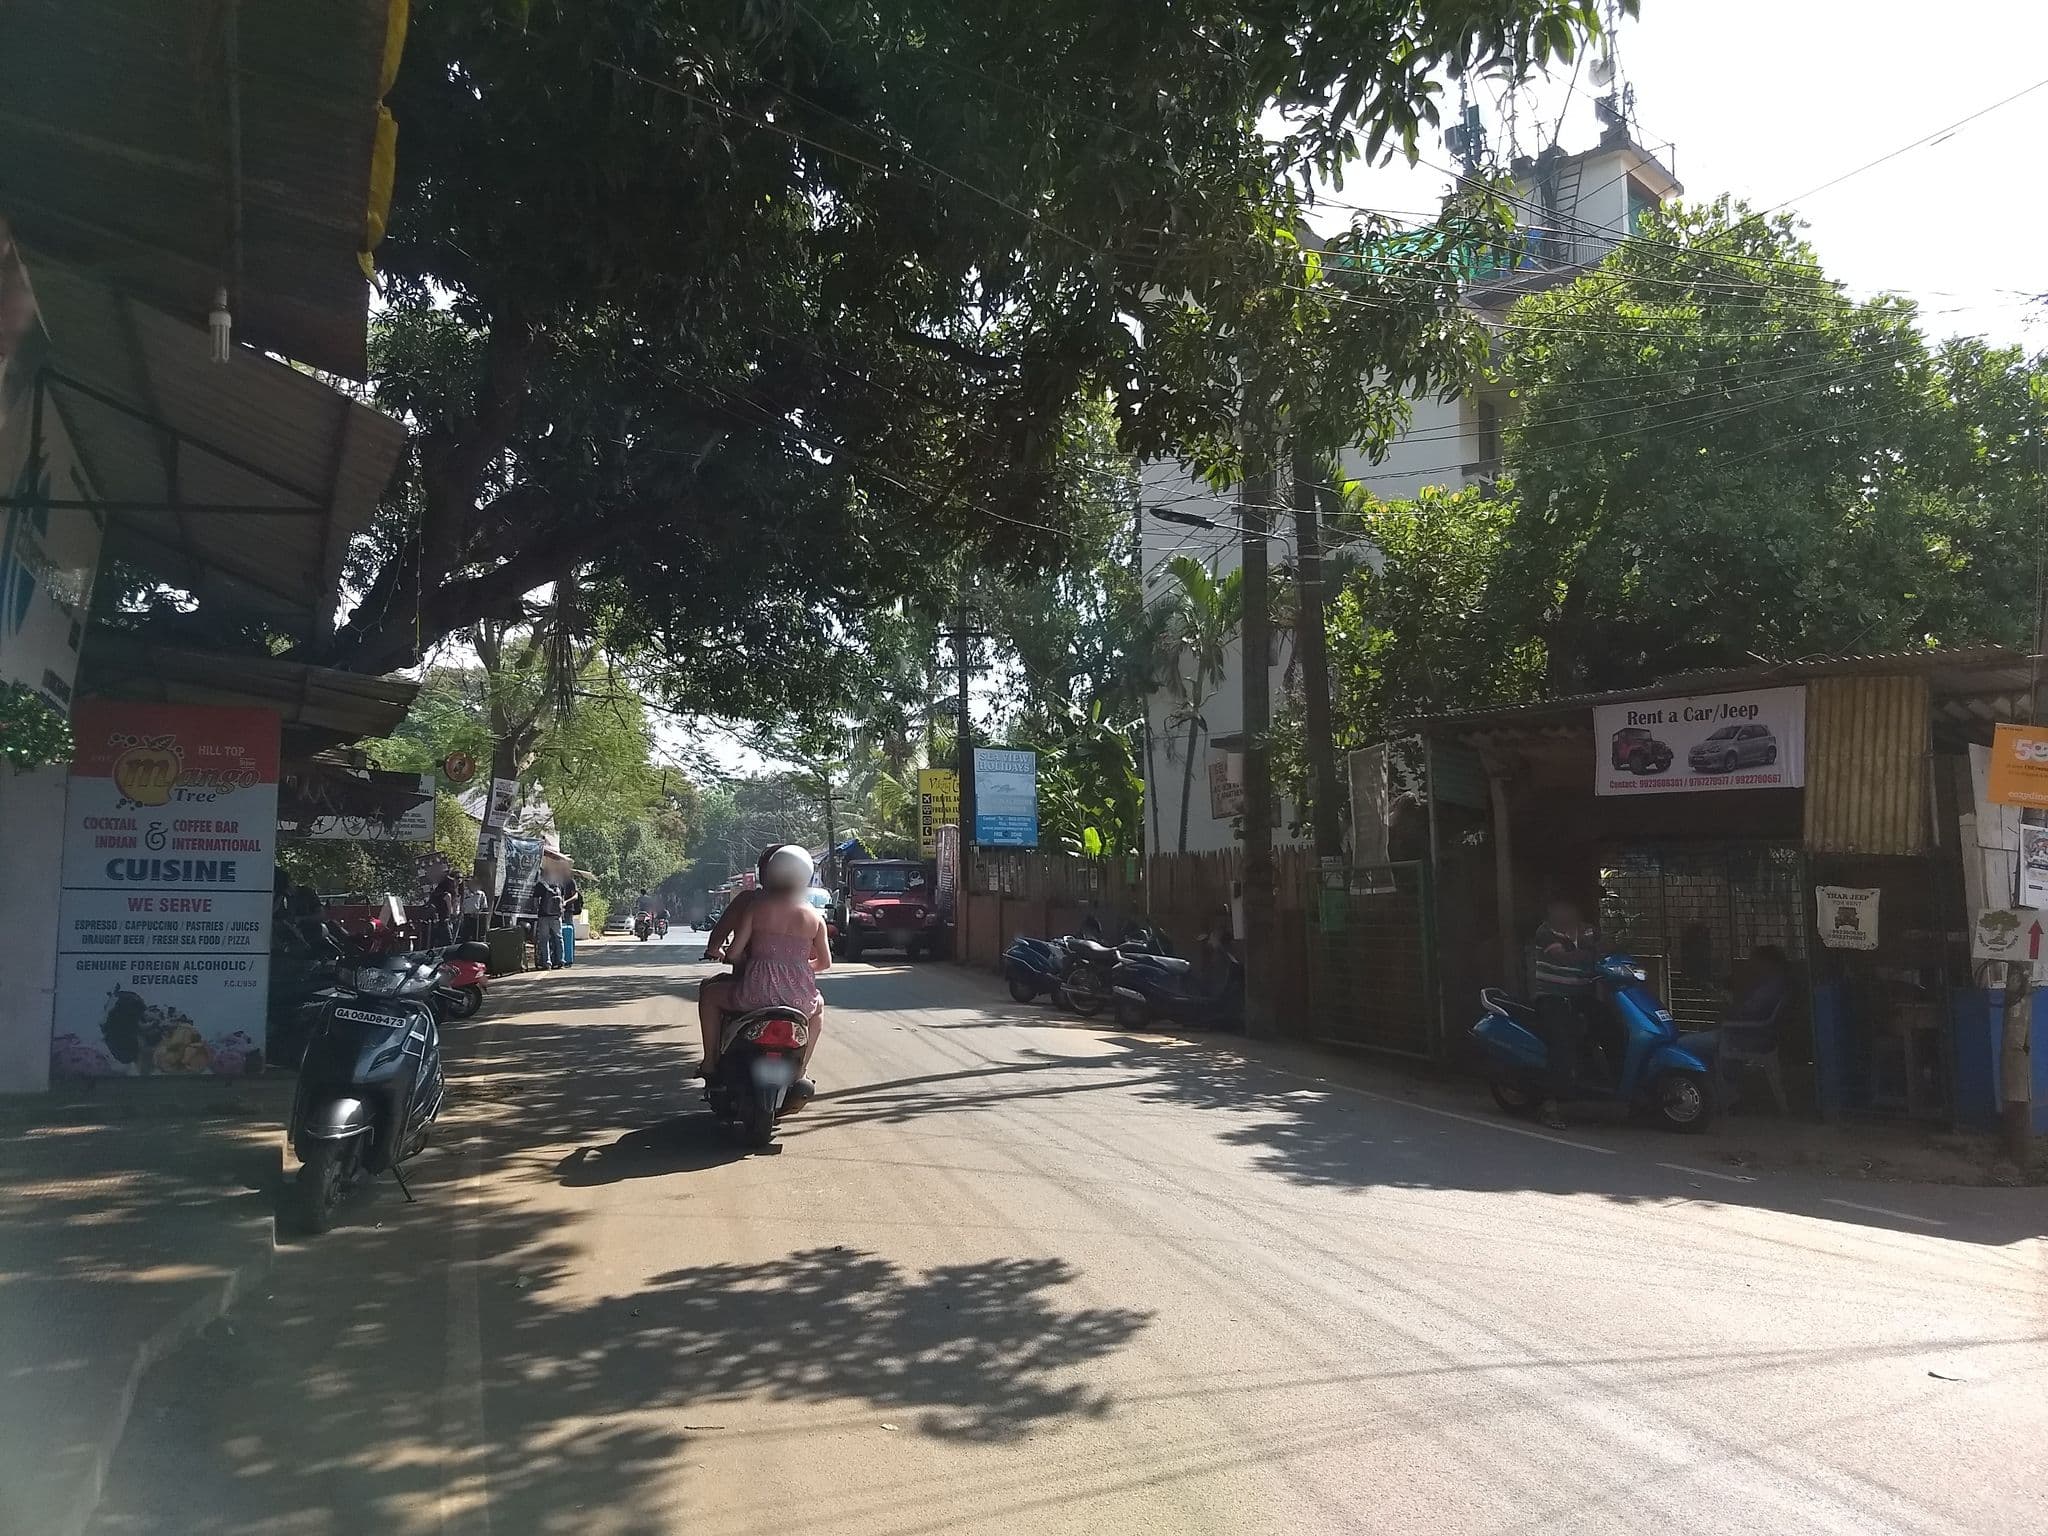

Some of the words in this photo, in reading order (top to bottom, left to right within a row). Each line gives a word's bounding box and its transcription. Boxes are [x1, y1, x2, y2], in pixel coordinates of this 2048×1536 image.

[1627, 709, 1664, 726] Rent
[1668, 713, 1678, 723] a
[1683, 703, 1759, 723] Car/Jeep
[198, 745, 221, 757] HILL
[225, 746, 246, 757] TOP
[1004, 752, 1028, 764] VIEW
[978, 761, 1030, 773] HOLIDAYS
[1610, 779, 1638, 789] Contact:
[175, 788, 217, 802] Tree
[83, 816, 137, 831] COCKTAIL
[145, 821, 169, 852] &
[172, 819, 212, 833] COFFEE
[215, 820, 239, 834] BAR
[95, 835, 137, 849] INDIAN
[172, 837, 262, 852] INTERNATIONAL
[106, 858, 236, 882] CUISINE
[127, 896, 154, 912] WE
[159, 897, 213, 913] SERVE
[74, 919, 118, 931] ESPRESSO
[125, 920, 178, 931] CAPPUCCINO
[186, 920, 224, 932] PASTRIES
[230, 921, 260, 932] JUICES
[82, 934, 122, 945] DRAUGHT
[123, 935, 145, 945] BEER
[152, 935, 179, 946] FRESH
[180, 935, 197, 946] SEA
[198, 935, 220, 946] FOOD
[227, 935, 250, 946] PIZZA
[76, 960, 127, 971] GENUINE
[130, 960, 180, 971] FOREIGN
[183, 960, 247, 972] ALCOHOLIC
[132, 974, 199, 985] BEVERAGES
